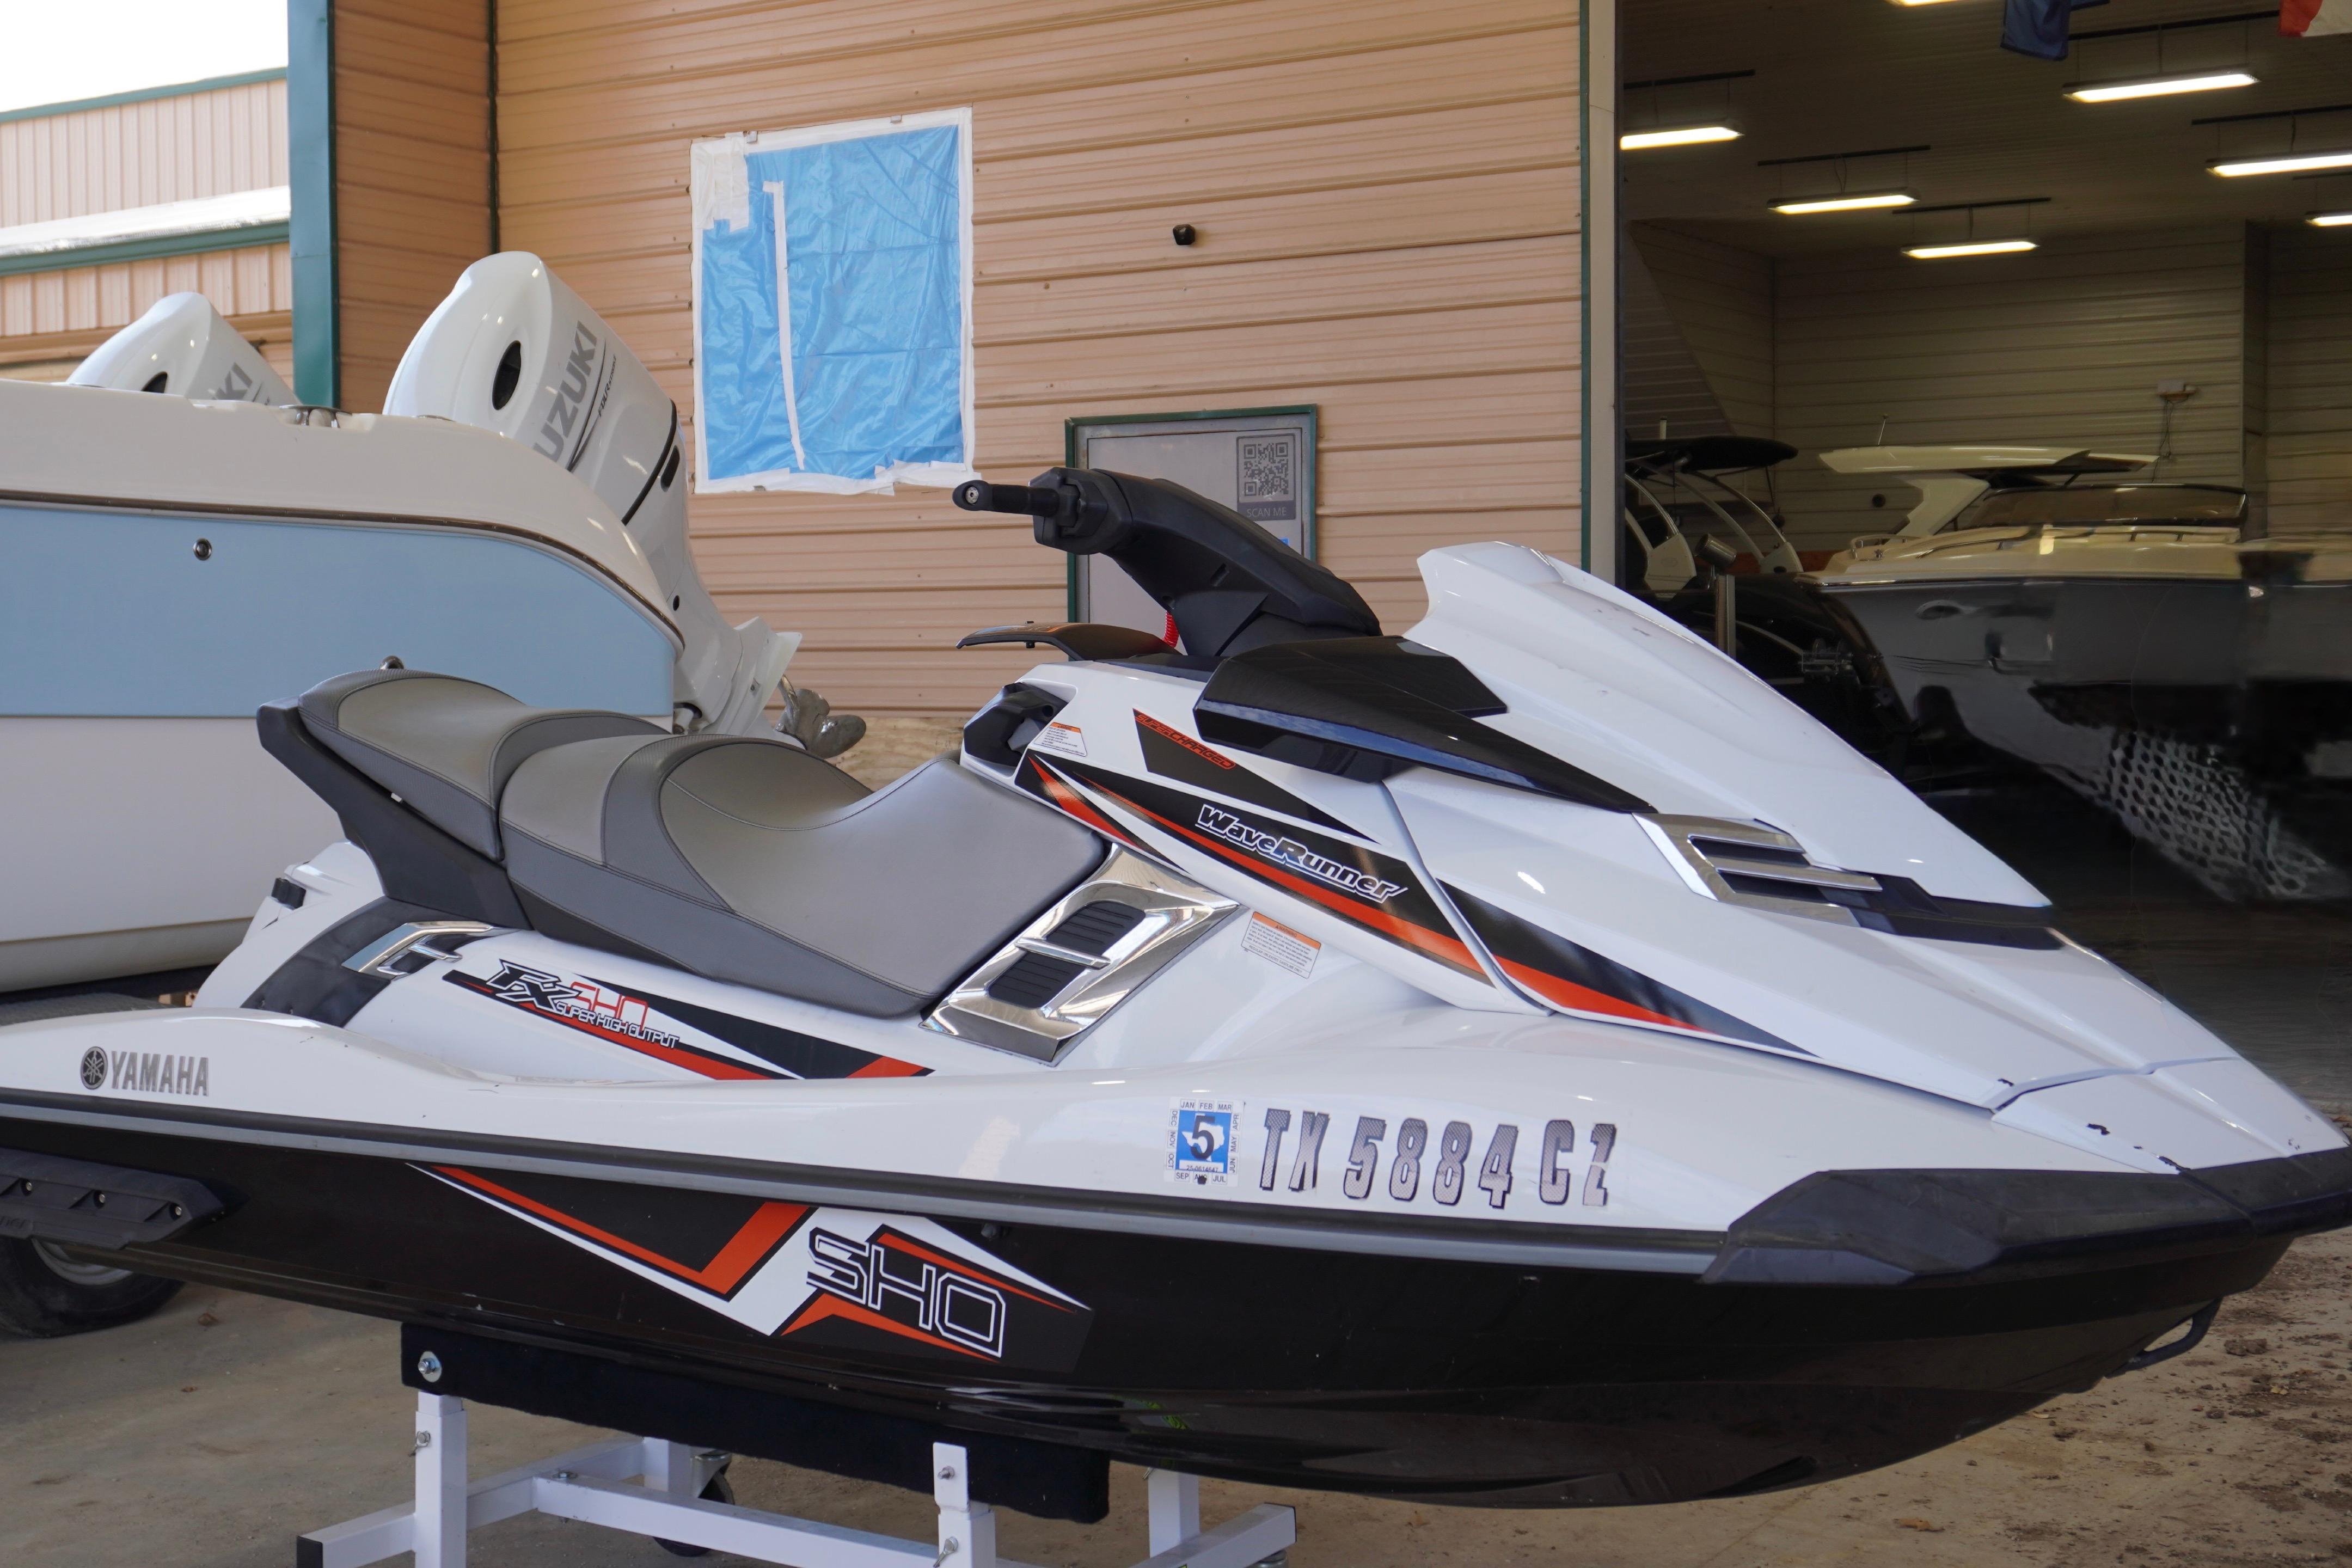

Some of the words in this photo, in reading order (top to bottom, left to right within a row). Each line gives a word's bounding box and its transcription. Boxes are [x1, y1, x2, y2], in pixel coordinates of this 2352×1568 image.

[534, 320, 597, 462] UZUKI
[1246, 507, 1270, 518] SCAN
[1273, 507, 1287, 516] ME
[1135, 713, 1236, 770] SUPERCHARGED
[1195, 804, 1408, 903] WaveRunner
[486, 958, 583, 1014] FX
[556, 1001, 595, 1025] SUPER
[595, 1013, 628, 1034] HIGH
[628, 1023, 680, 1049] OUTPUT
[111, 1051, 209, 1097] YAMAHA
[1191, 1115, 1215, 1159] 5
[1259, 1108, 1330, 1191] TX
[1343, 1115, 1518, 1210] 5884
[1539, 1119, 1617, 1206] CZ
[806, 1226, 1006, 1358] SHO
